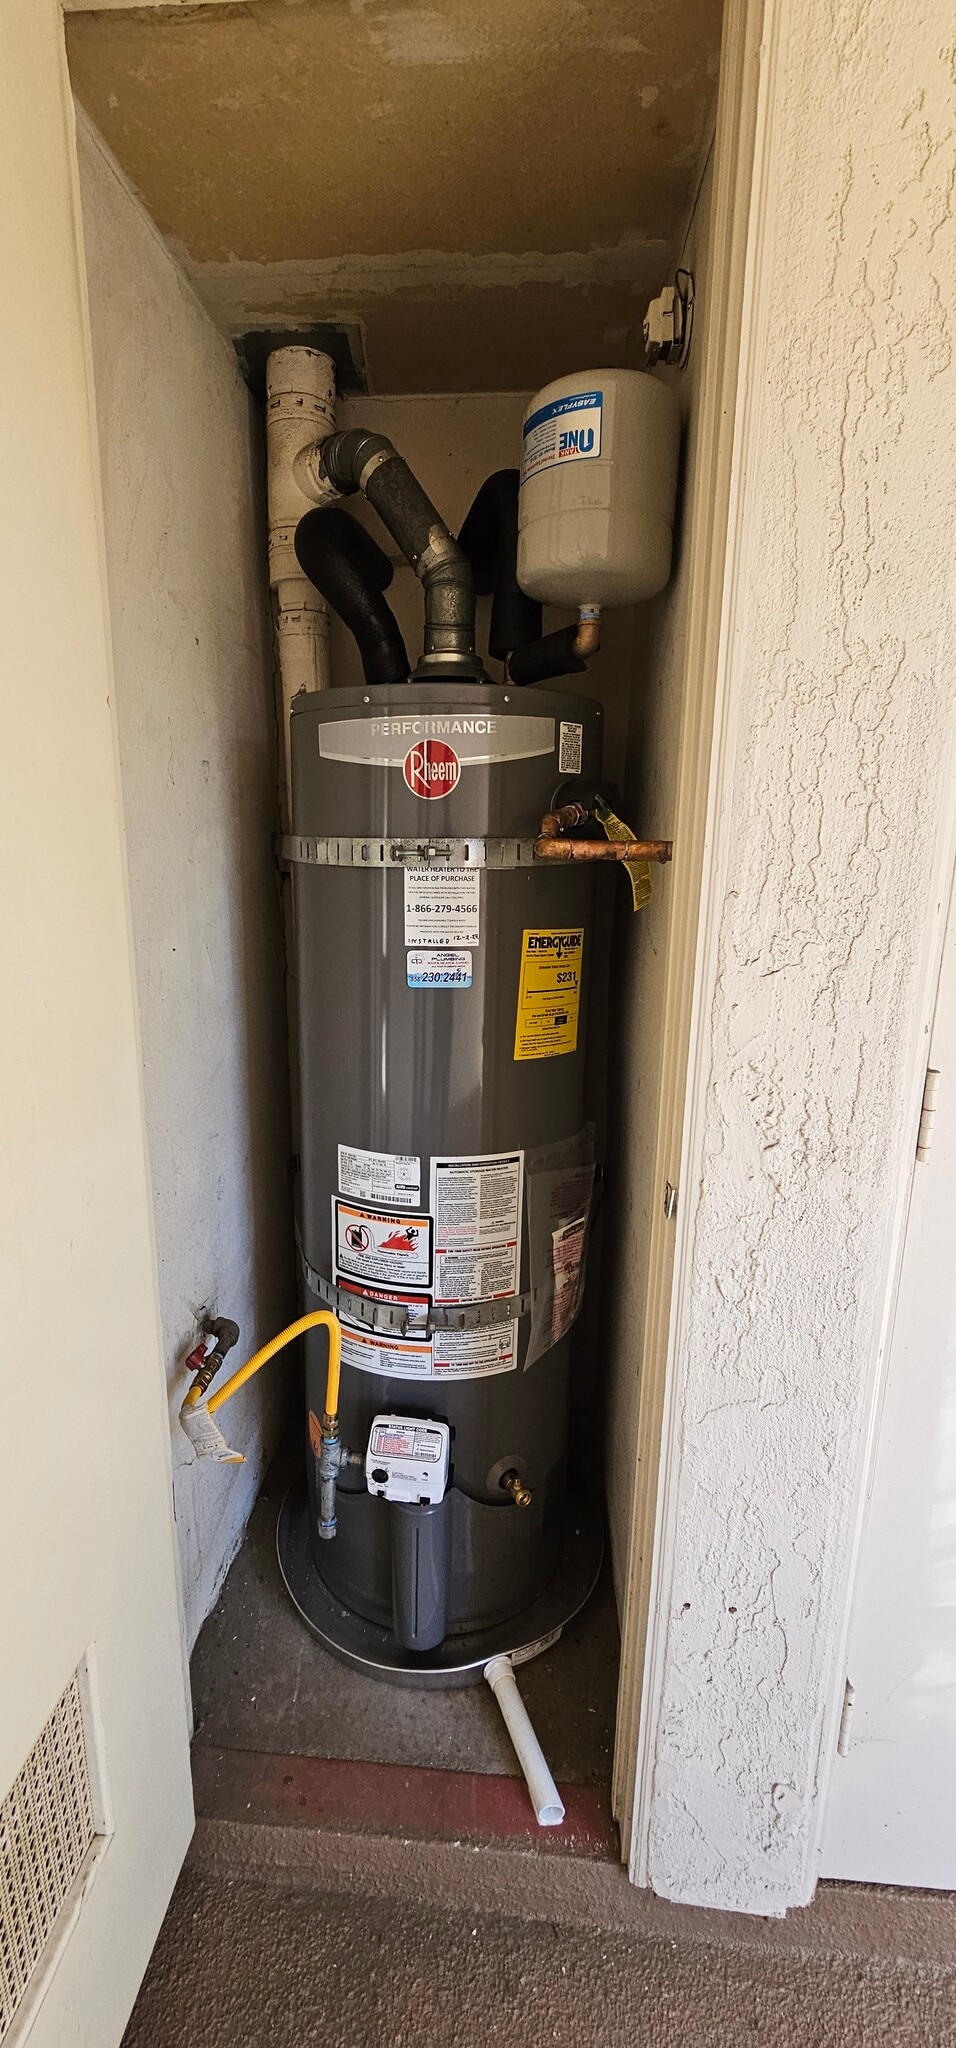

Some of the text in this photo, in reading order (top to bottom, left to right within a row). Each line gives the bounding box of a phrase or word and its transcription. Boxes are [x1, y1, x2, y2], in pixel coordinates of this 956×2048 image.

[551, 398, 596, 415] EASYFLEX
[560, 428, 594, 452] ONE
[560, 447, 578, 457] TANK
[371, 720, 497, 736] PERFORMANCE
[410, 740, 456, 789] Rheem
[406, 904, 478, 913] 1-866-279-4566
[528, 935, 582, 949] ENERGYGUIDE
[422, 972, 467, 982] 230.2441
[556, 971, 576, 983] $231
[368, 1214, 400, 1224] WARNING
[370, 1291, 398, 1301] DANGER
[370, 1340, 399, 1350] WARNING
